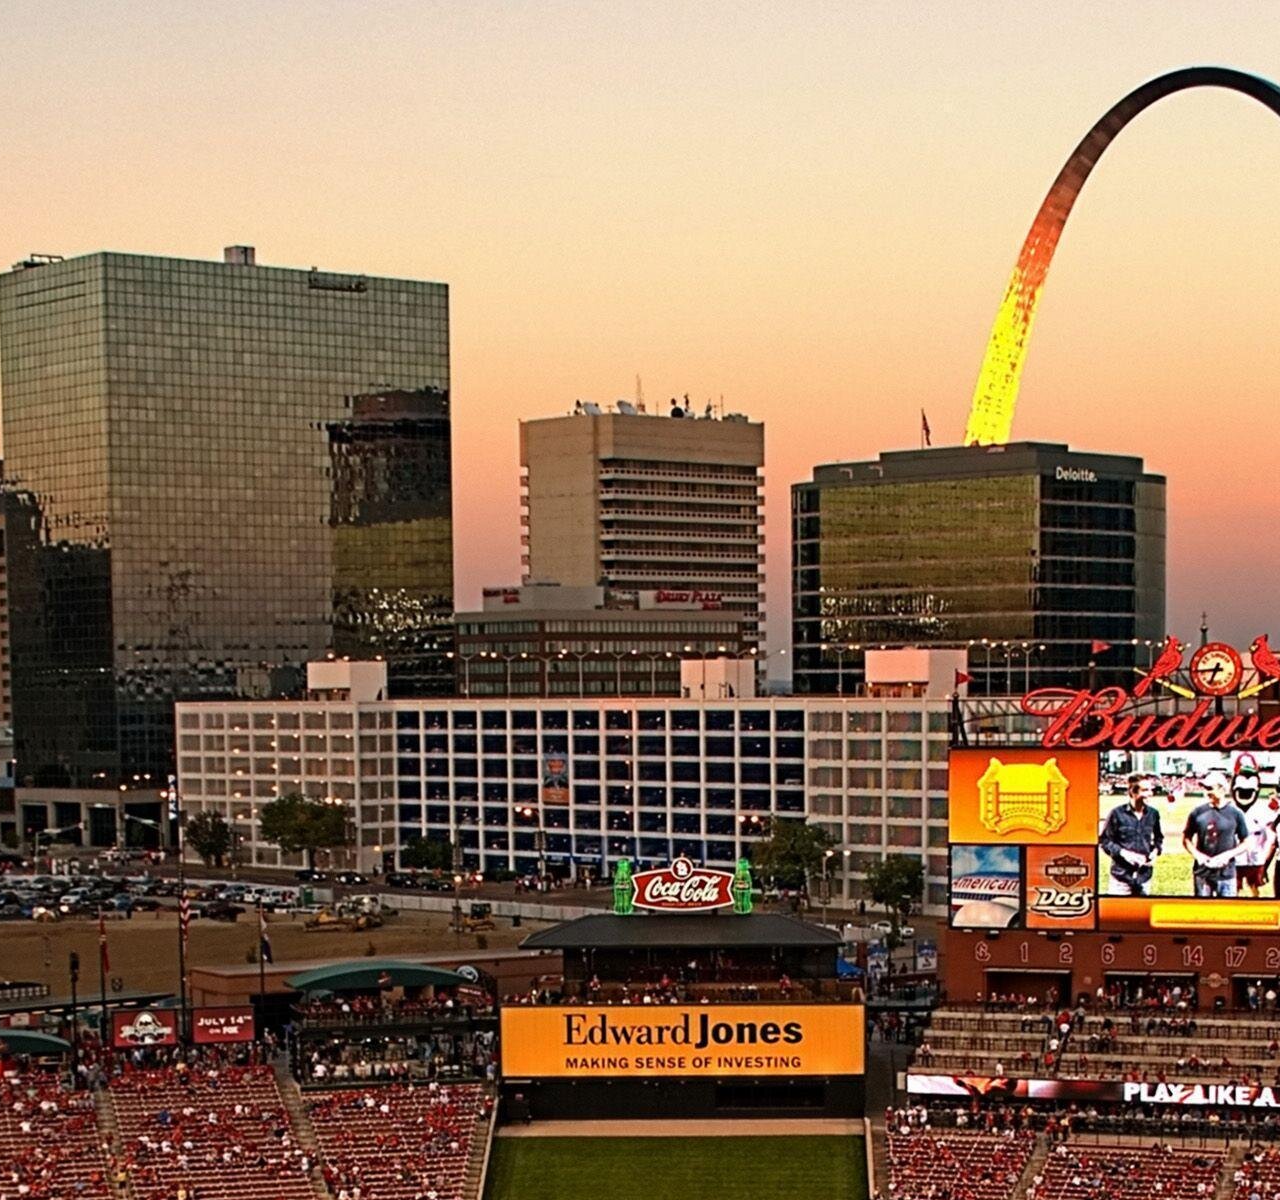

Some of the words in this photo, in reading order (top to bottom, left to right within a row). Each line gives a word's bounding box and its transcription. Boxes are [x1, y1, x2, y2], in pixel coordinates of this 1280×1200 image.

[645, 875, 722, 902] Coca-Cola
[1020, 942, 1029, 962] 1
[1059, 942, 1072, 963] 2
[1101, 943, 1115, 964] 6
[1143, 944, 1157, 965] 9
[1183, 945, 1204, 966] 14
[1225, 946, 1247, 967] 17
[198, 1017, 225, 1026] JULY
[223, 1026, 239, 1034] FOX
[563, 1013, 690, 1046] Edward
[694, 1014, 803, 1049] Jones
[565, 1057, 629, 1069] MAKING
[634, 1057, 687, 1069] SENSE
[692, 1057, 712, 1068] OF
[717, 1056, 802, 1069] INVESTING
[1123, 1082, 1180, 1103] PLAY
[1254, 1085, 1275, 1107] A
